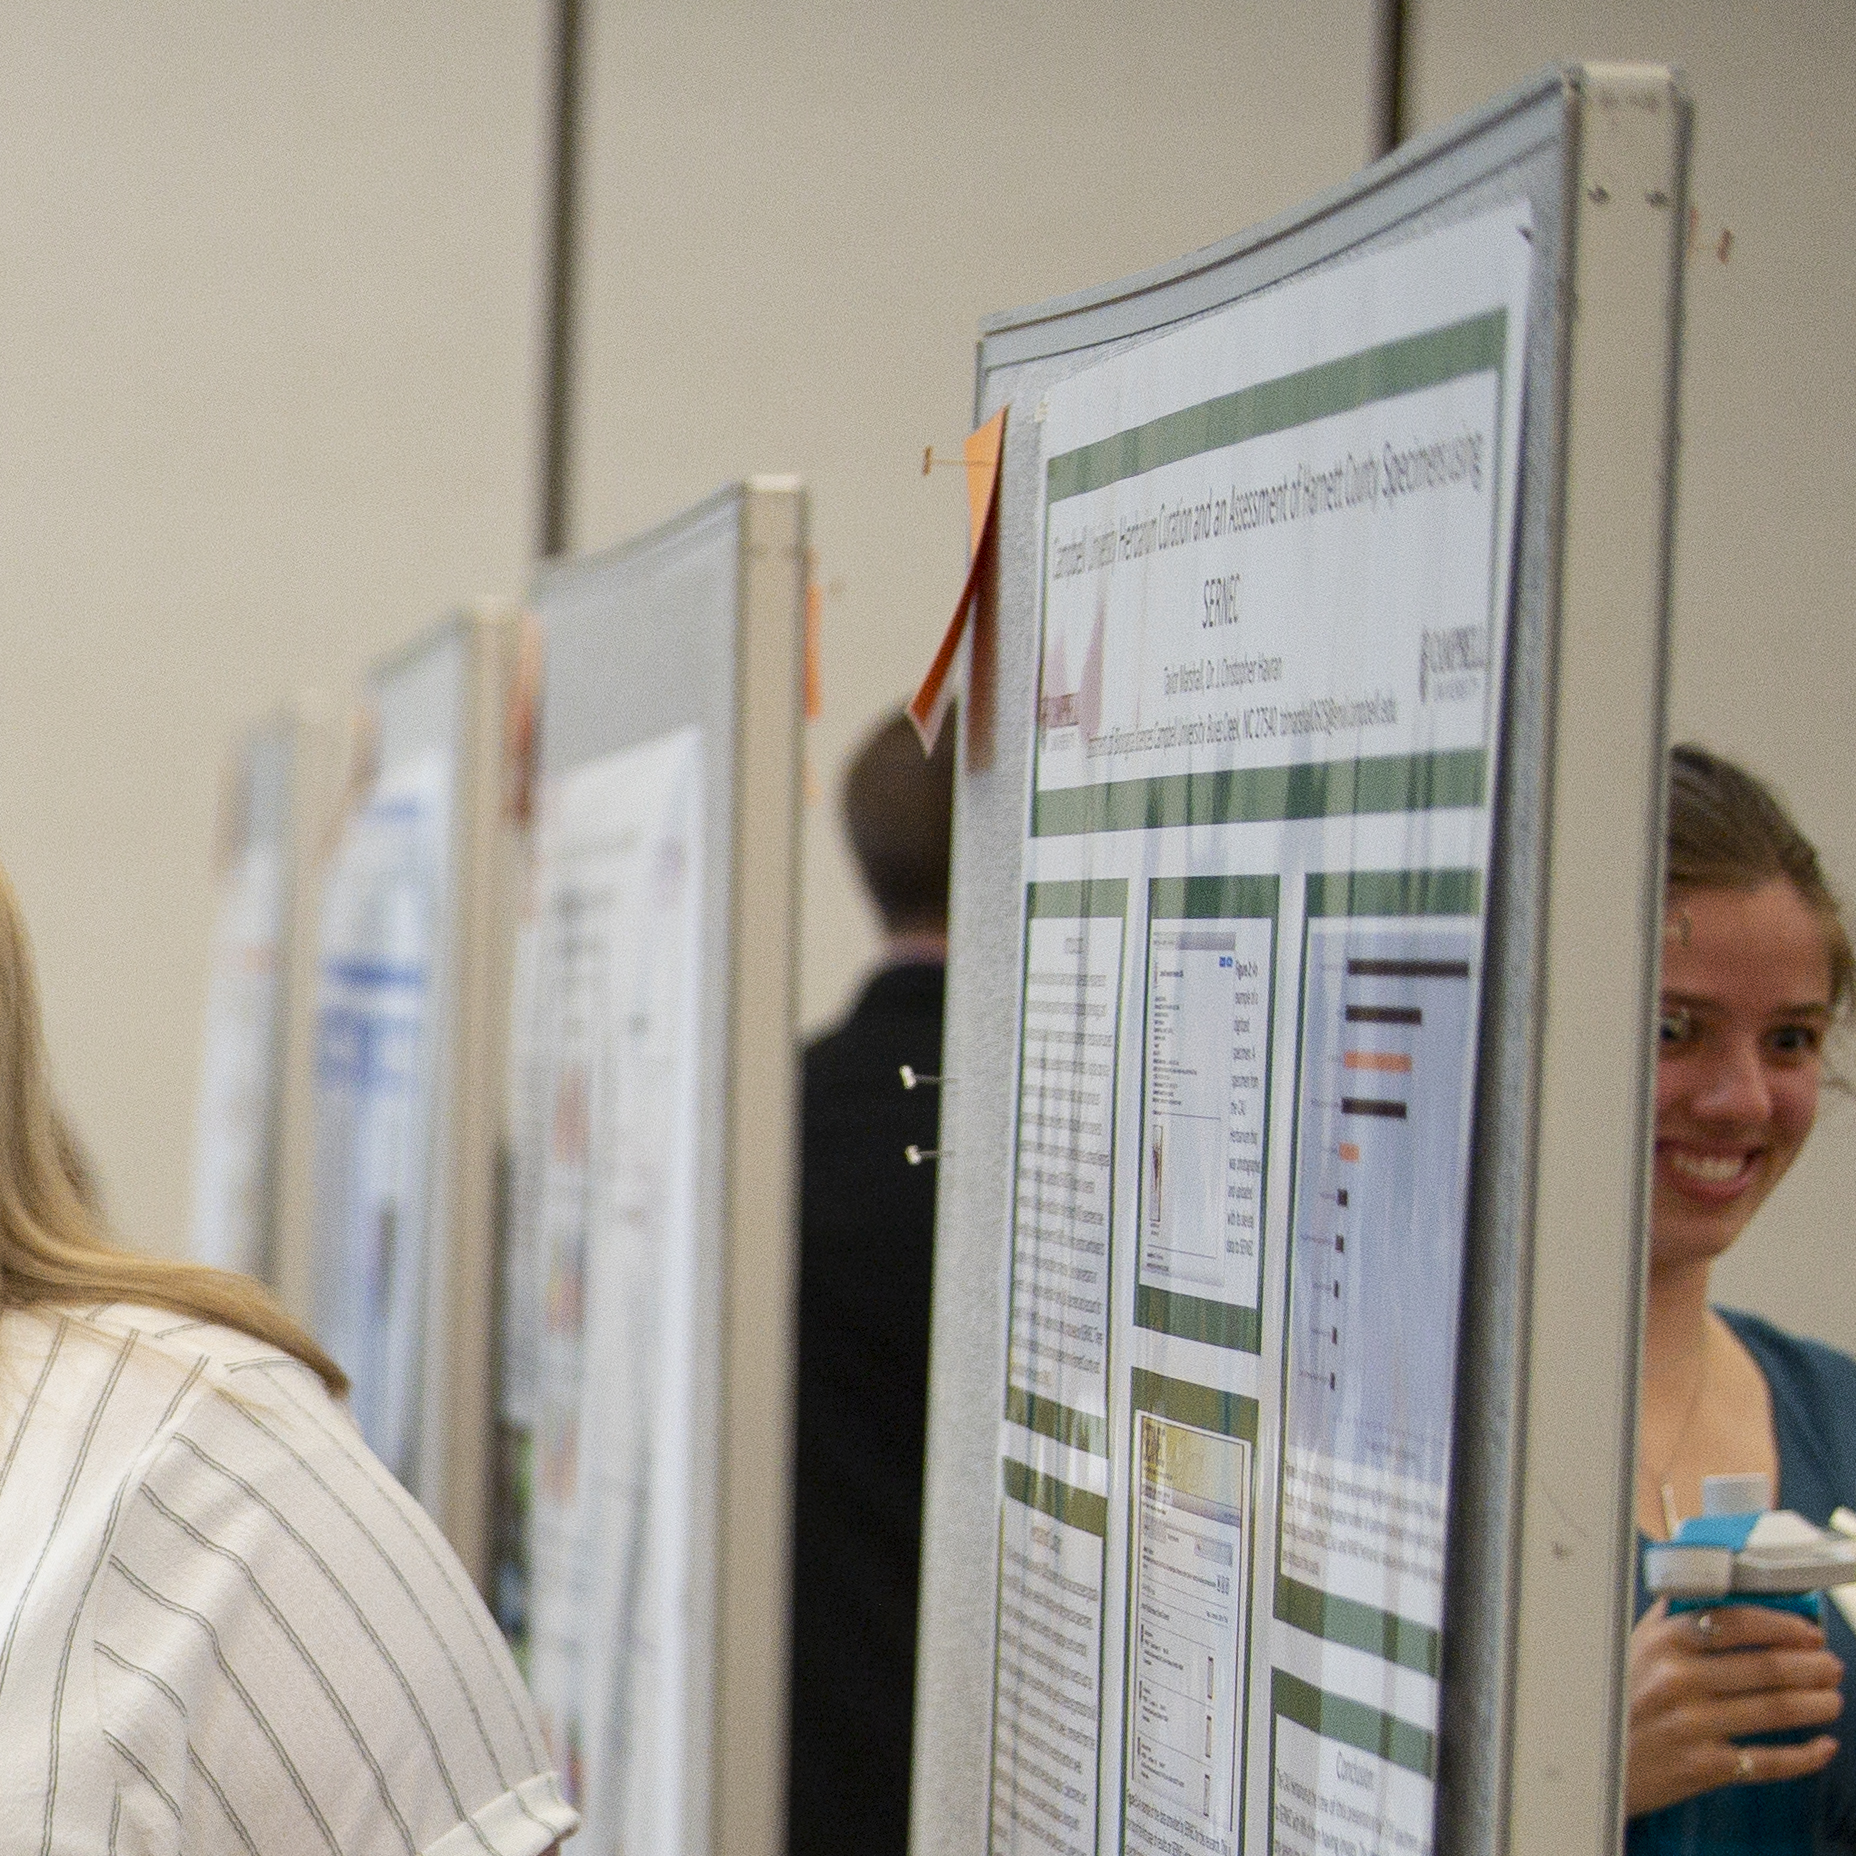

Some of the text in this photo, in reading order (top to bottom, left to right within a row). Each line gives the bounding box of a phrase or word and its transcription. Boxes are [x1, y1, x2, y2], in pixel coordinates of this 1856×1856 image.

[1157, 496, 1192, 550] Curation
[1193, 487, 1212, 542] and
[1214, 499, 1227, 537] an
[1229, 475, 1288, 535] Assessment
[1289, 462, 1302, 521] of
[1202, 573, 1241, 628] SERNEC
